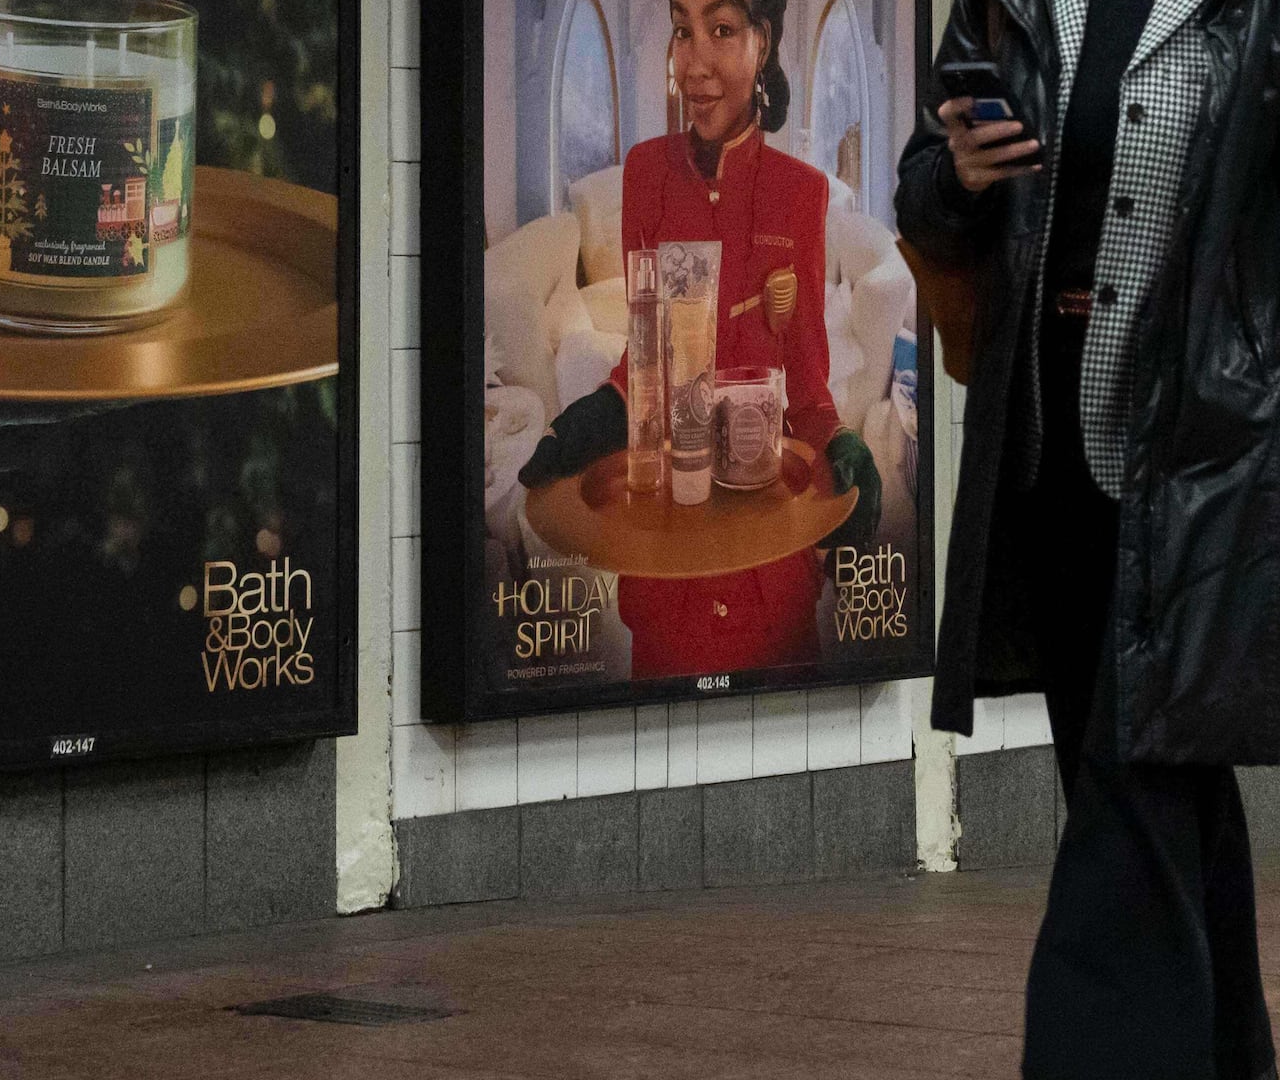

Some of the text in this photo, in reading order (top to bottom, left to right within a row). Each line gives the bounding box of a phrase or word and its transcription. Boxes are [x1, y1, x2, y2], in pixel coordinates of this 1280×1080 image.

[48, 135, 96, 154] FRESH
[41, 157, 101, 178] BALSAM
[34, 239, 106, 253] exclusively fragranced
[28, 253, 109, 265] SOY WAX BLEND CANDLE
[526, 554, 589, 569] All aboard the
[835, 543, 905, 588] Bath
[203, 556, 312, 617] Bath
[493, 573, 619, 617] HOLIDAY
[515, 608, 600, 658] SPIRIT
[834, 608, 908, 642] Works
[201, 647, 314, 692] Works
[508, 660, 605, 679] POWERED BY FRAGRANCE
[696, 675, 730, 689] 402-145
[52, 737, 95, 755] 402-147
